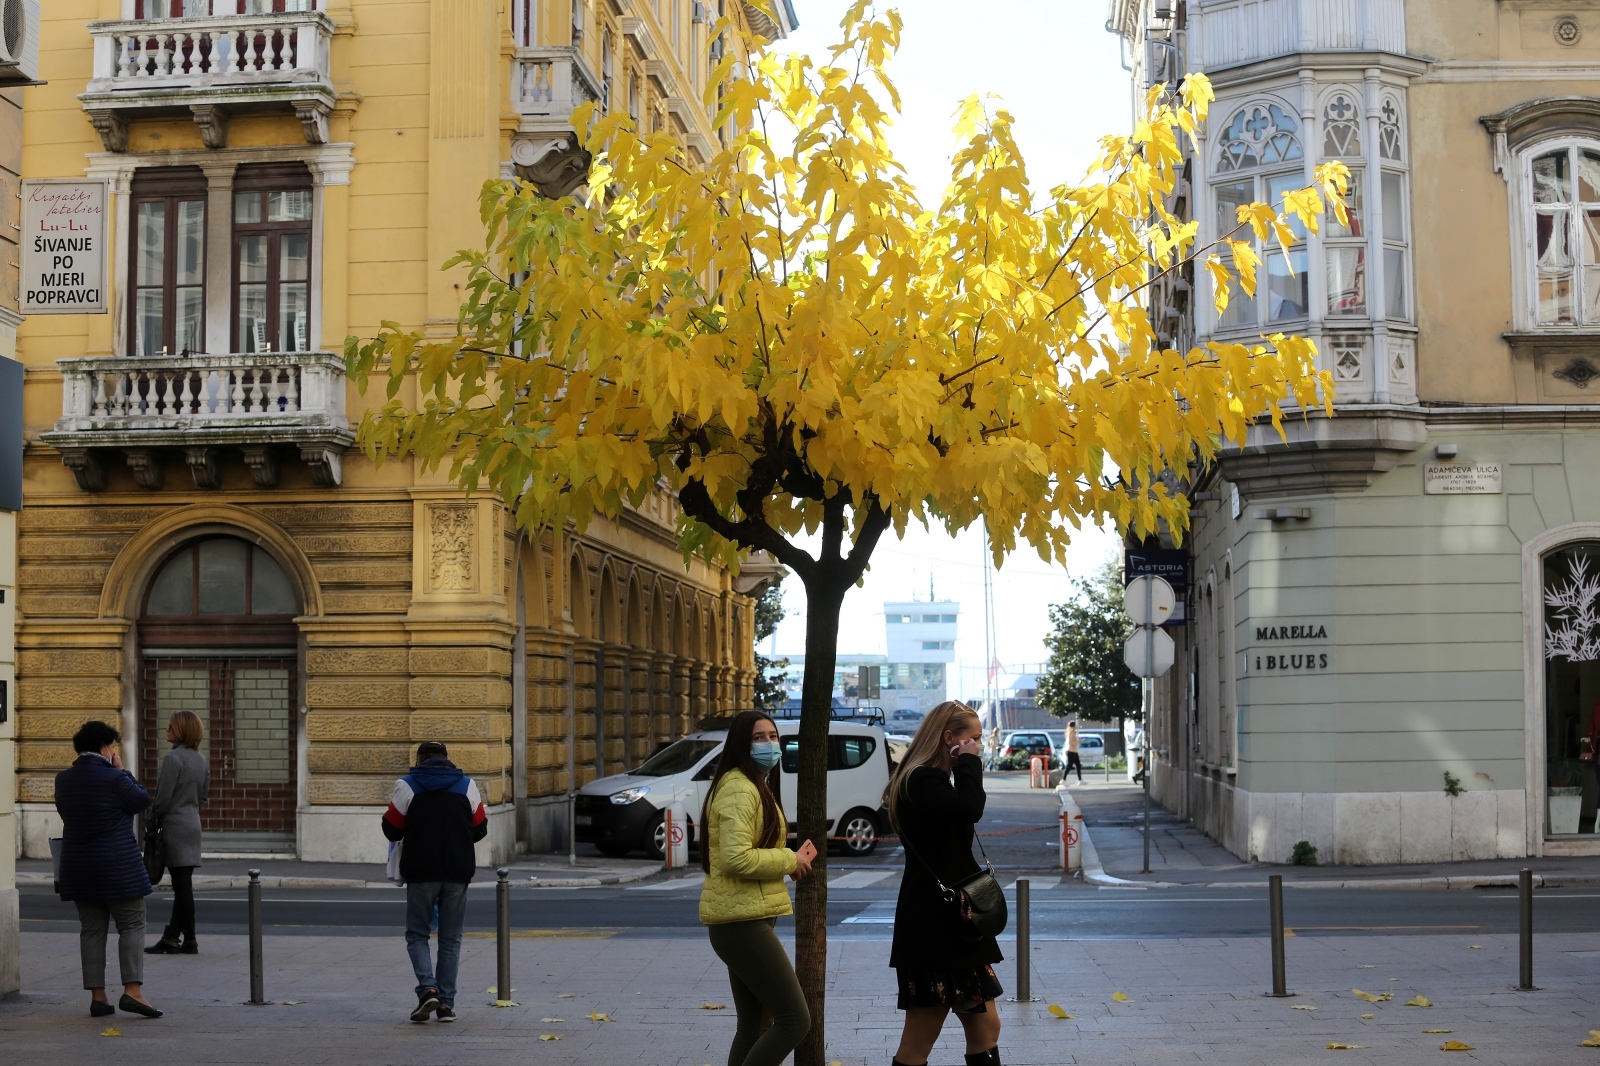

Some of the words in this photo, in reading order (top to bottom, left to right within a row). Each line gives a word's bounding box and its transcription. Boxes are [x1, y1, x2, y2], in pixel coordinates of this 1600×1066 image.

[29, 186, 93, 216] Krojački
[51, 201, 102, 215] atelier
[40, 219, 88, 232] Lu-Lu
[34, 236, 92, 252] ŠIVANJE
[53, 255, 74, 269] PO
[41, 272, 85, 287] MJERI
[26, 289, 99, 304] POPRAVCI
[1428, 465, 1472, 473] ADAMIĆEVA
[1256, 625, 1327, 640] MARELLA
[1256, 656, 1261, 669] i
[1266, 653, 1328, 670] BLUES
